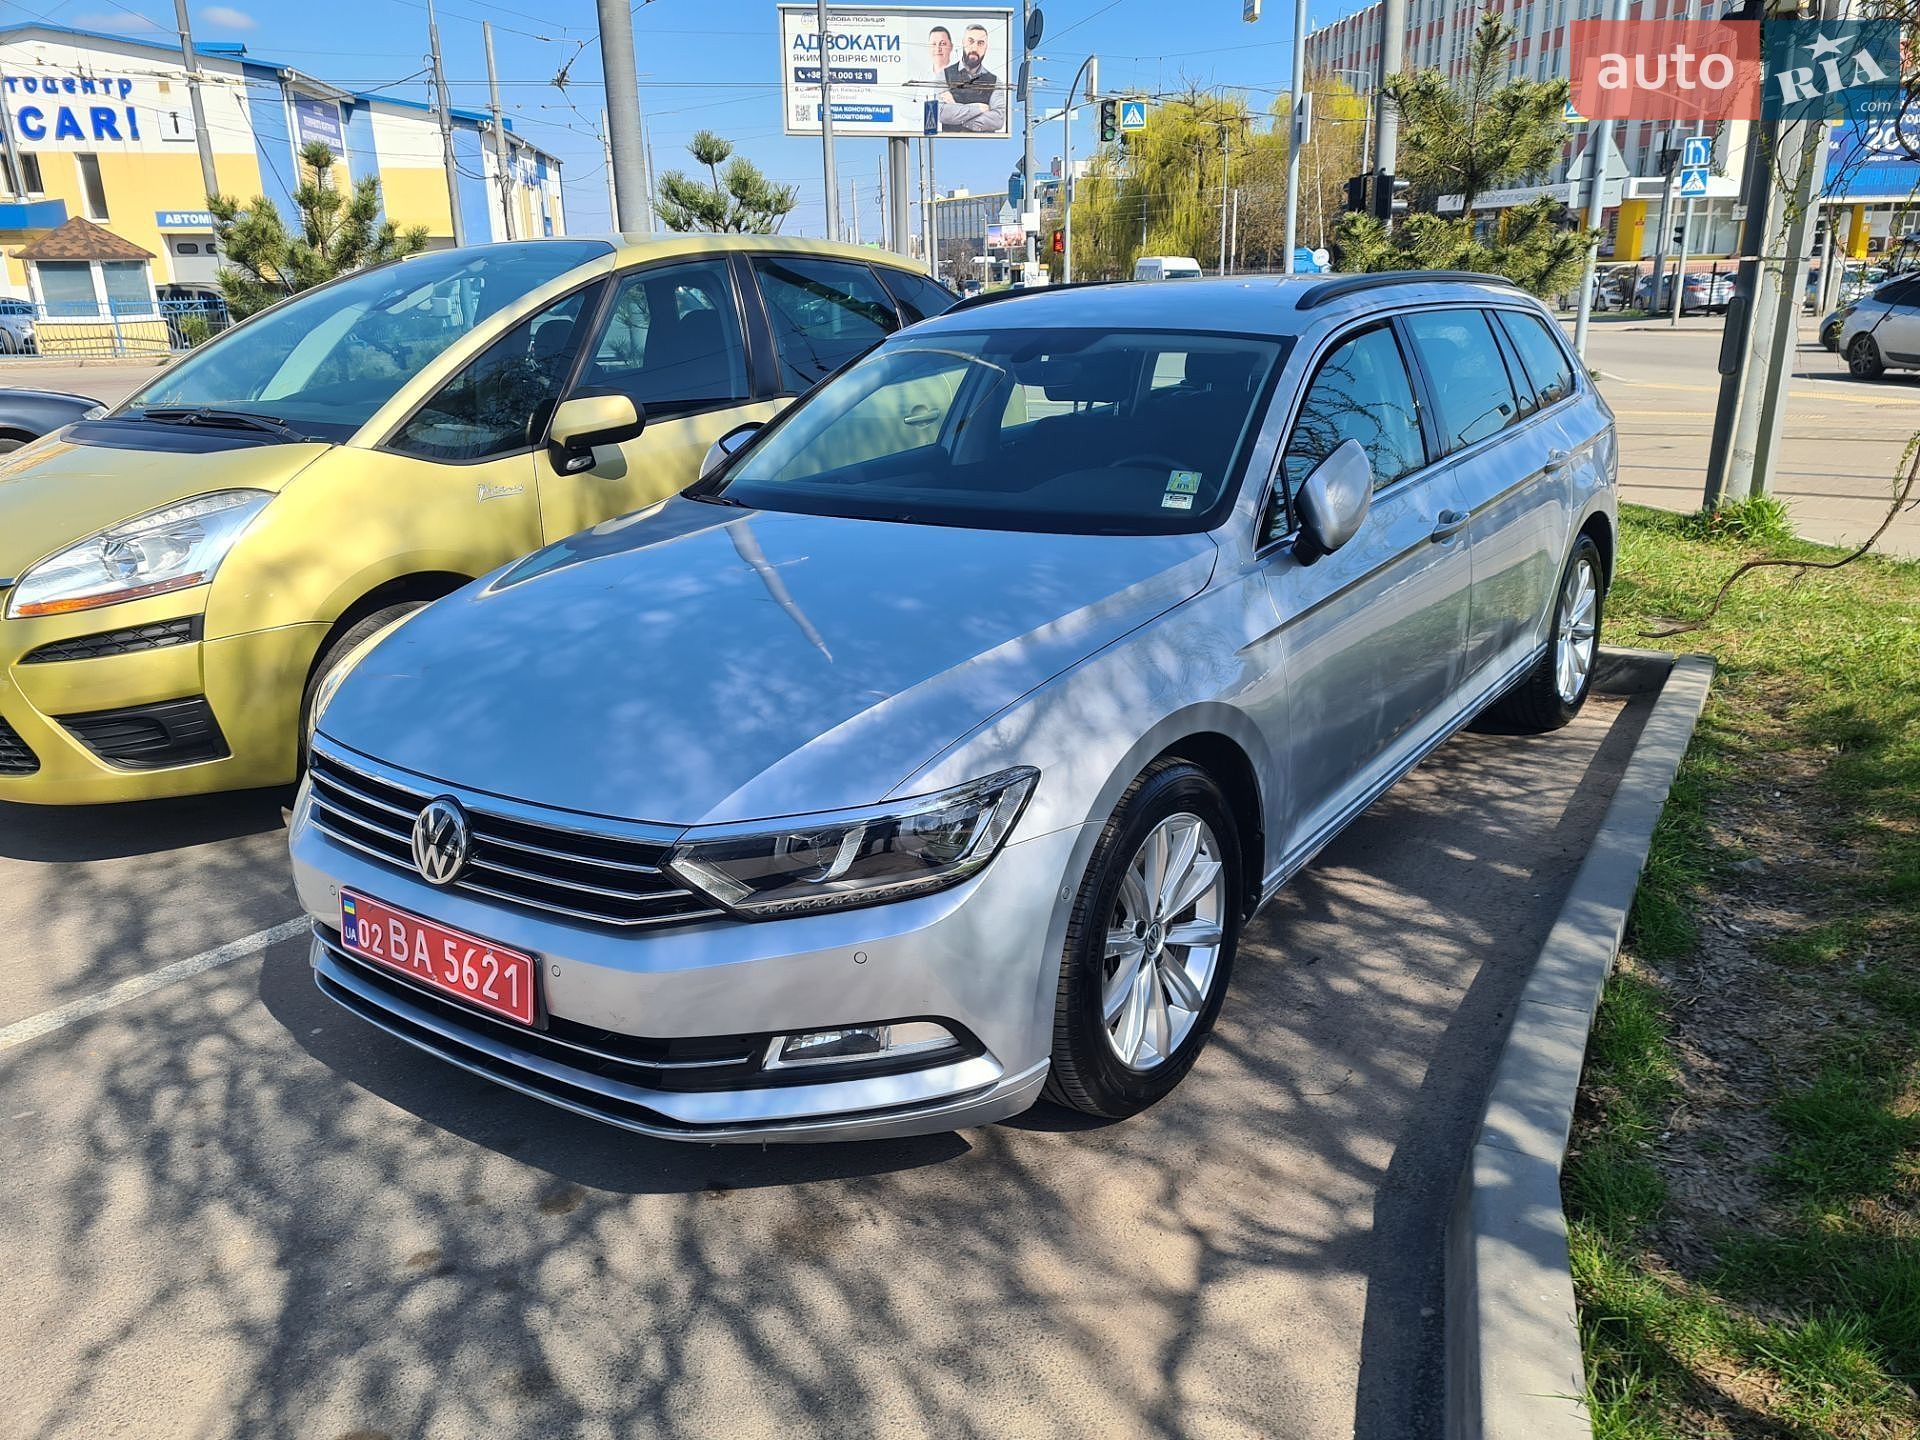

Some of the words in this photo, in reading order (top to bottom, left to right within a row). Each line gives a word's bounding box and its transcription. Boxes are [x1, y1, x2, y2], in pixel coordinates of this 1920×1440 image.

[793, 34, 900, 52] АДВОКАТИ
[829, 54, 868, 63] ОВІРЯЄ
[870, 54, 901, 63] МІСТО
[165, 213, 211, 224] АВТОМ
[345, 927, 357, 942] UA
[443, 939, 518, 1008] 5621
